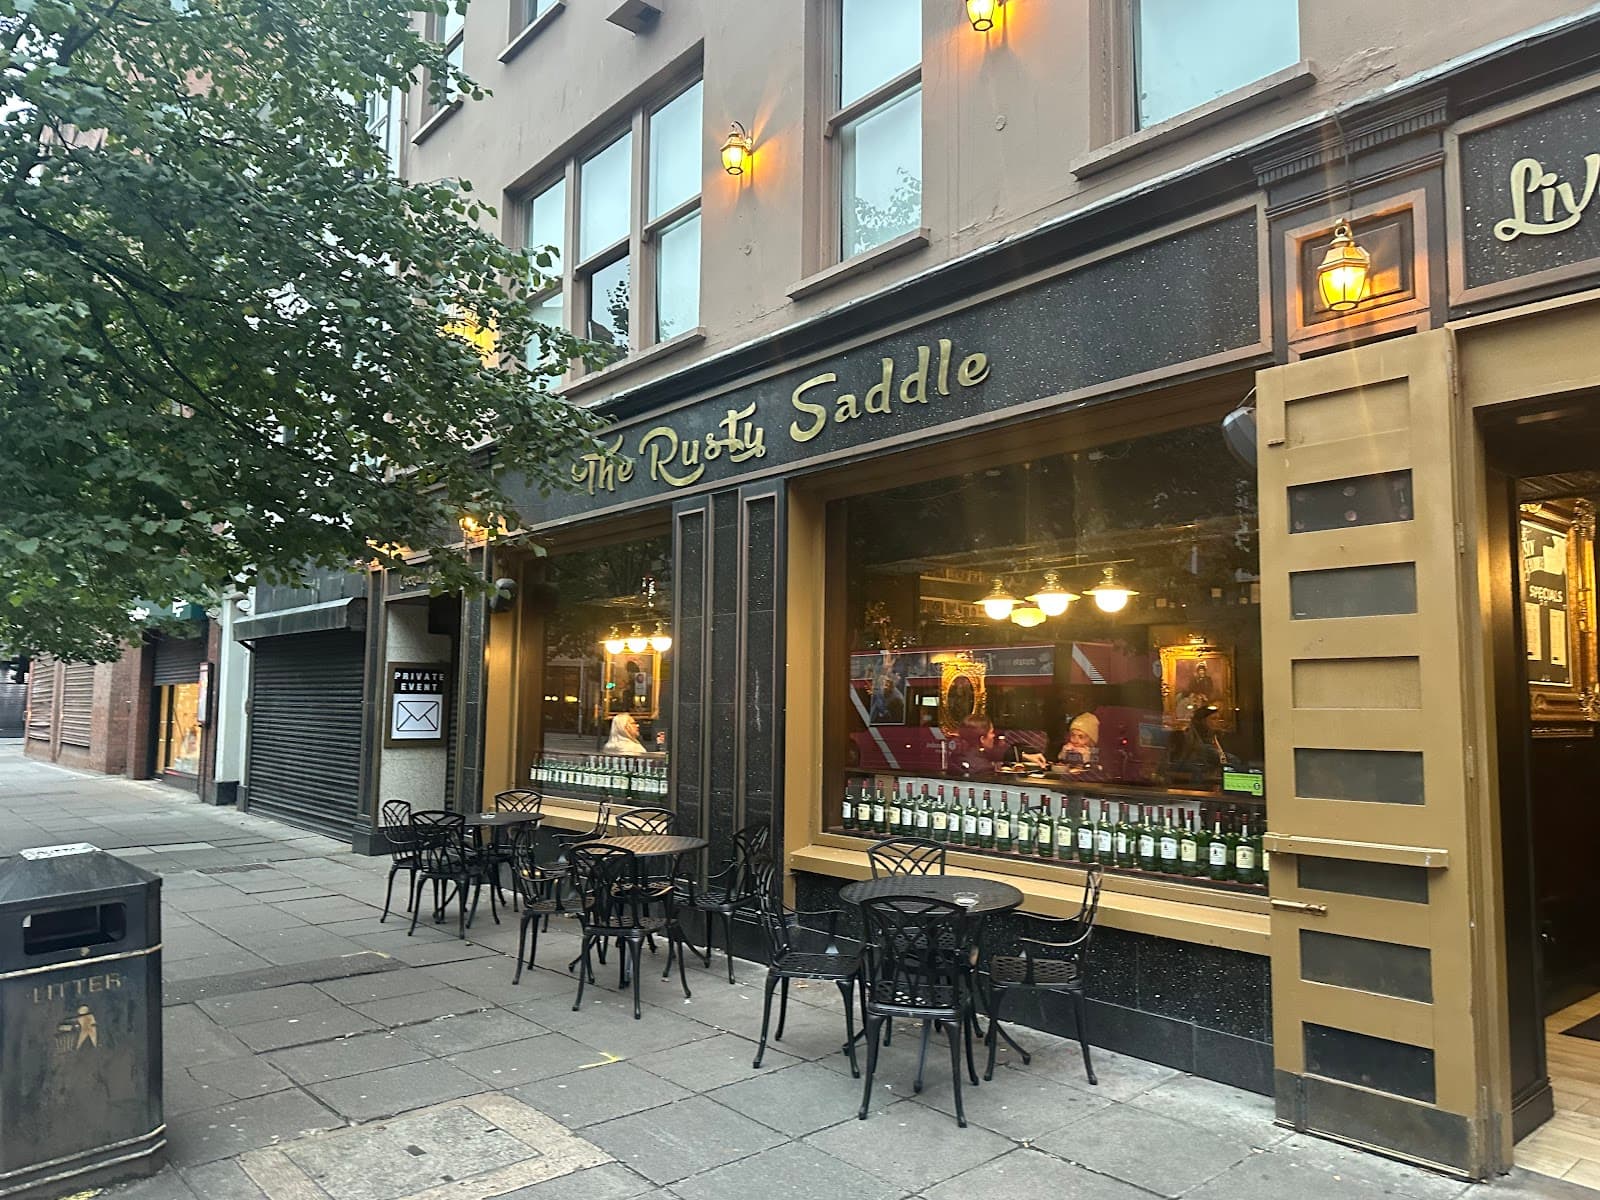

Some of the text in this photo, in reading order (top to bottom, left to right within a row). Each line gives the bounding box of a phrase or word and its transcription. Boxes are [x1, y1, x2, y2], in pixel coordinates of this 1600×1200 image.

[1494, 153, 1600, 242] Liv
[571, 338, 991, 495] The Rusty Saddle
[394, 671, 445, 681] PRIVATE
[400, 682, 438, 691] EVENT
[32, 972, 121, 1004] LITTER
